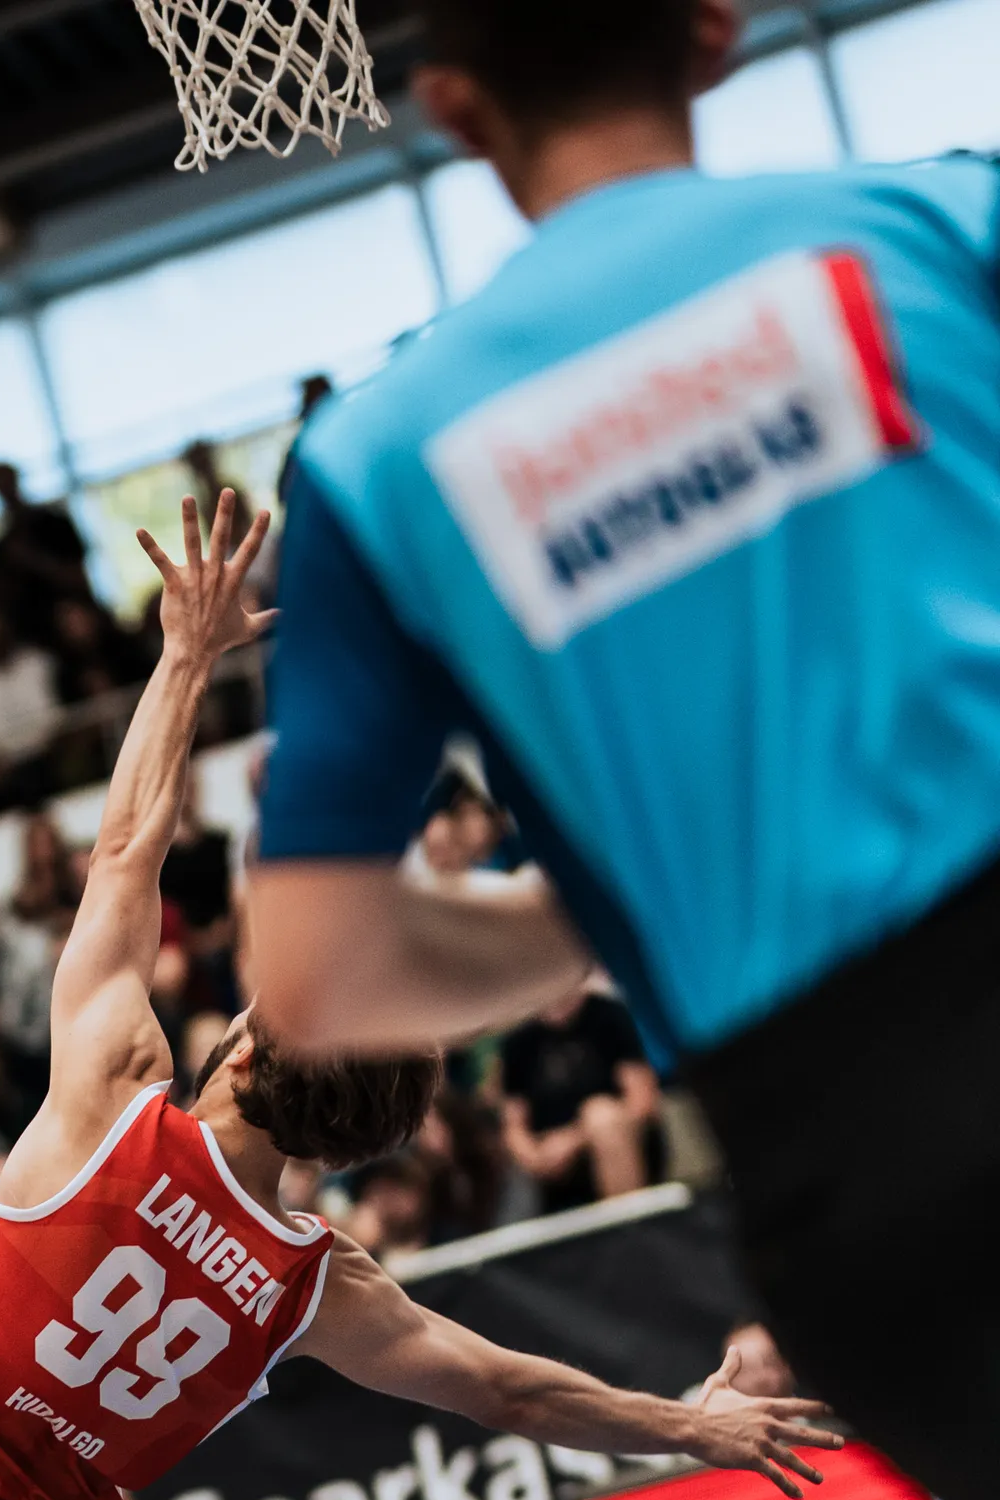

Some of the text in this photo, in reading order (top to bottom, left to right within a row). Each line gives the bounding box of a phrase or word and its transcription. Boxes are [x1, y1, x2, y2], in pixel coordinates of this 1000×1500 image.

[134, 1172, 287, 1327] LANGEN
[34, 1244, 232, 1421] 99
[4, 1386, 106, 1461] HIDALGO
